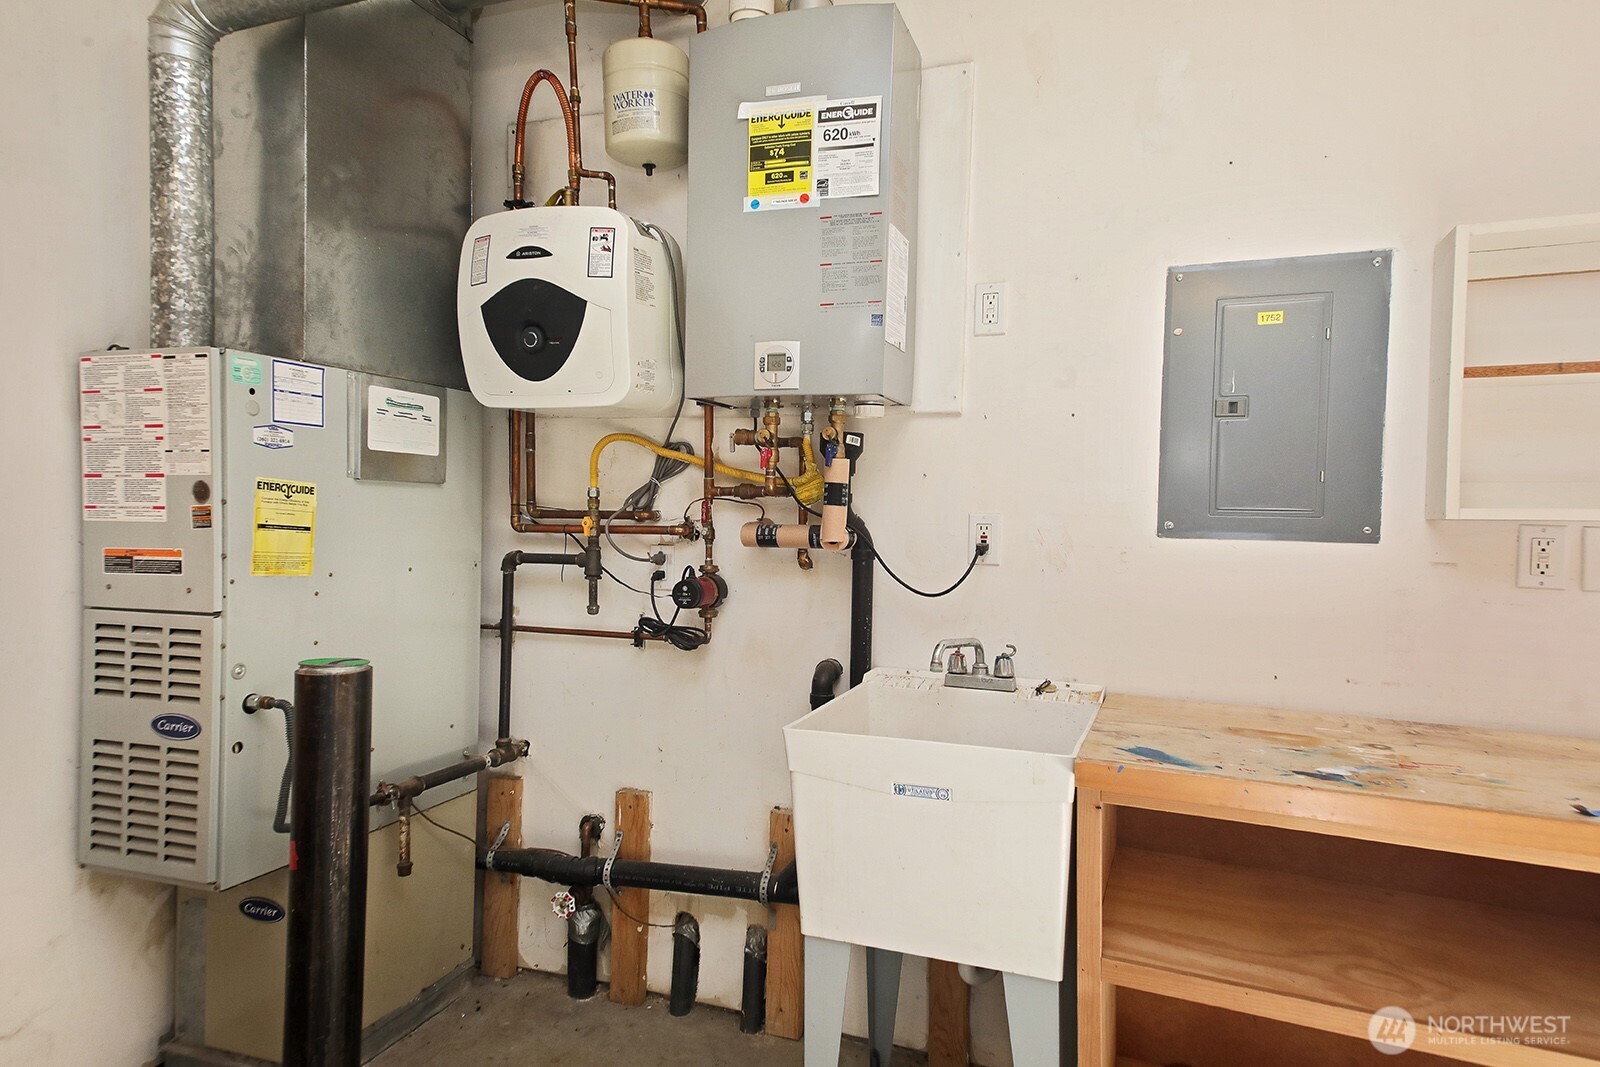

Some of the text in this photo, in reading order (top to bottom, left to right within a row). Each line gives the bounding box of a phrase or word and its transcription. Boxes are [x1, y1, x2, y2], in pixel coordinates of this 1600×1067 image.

[612, 91, 643, 102] WATER
[613, 98, 655, 110] WORKER
[823, 127, 849, 142] 620
[769, 147, 785, 157] $74
[1261, 314, 1281, 322] 1752
[257, 481, 315, 496] ENERGYGUIDE
[157, 719, 194, 733] Carrier
[243, 902, 278, 917] Carrier
